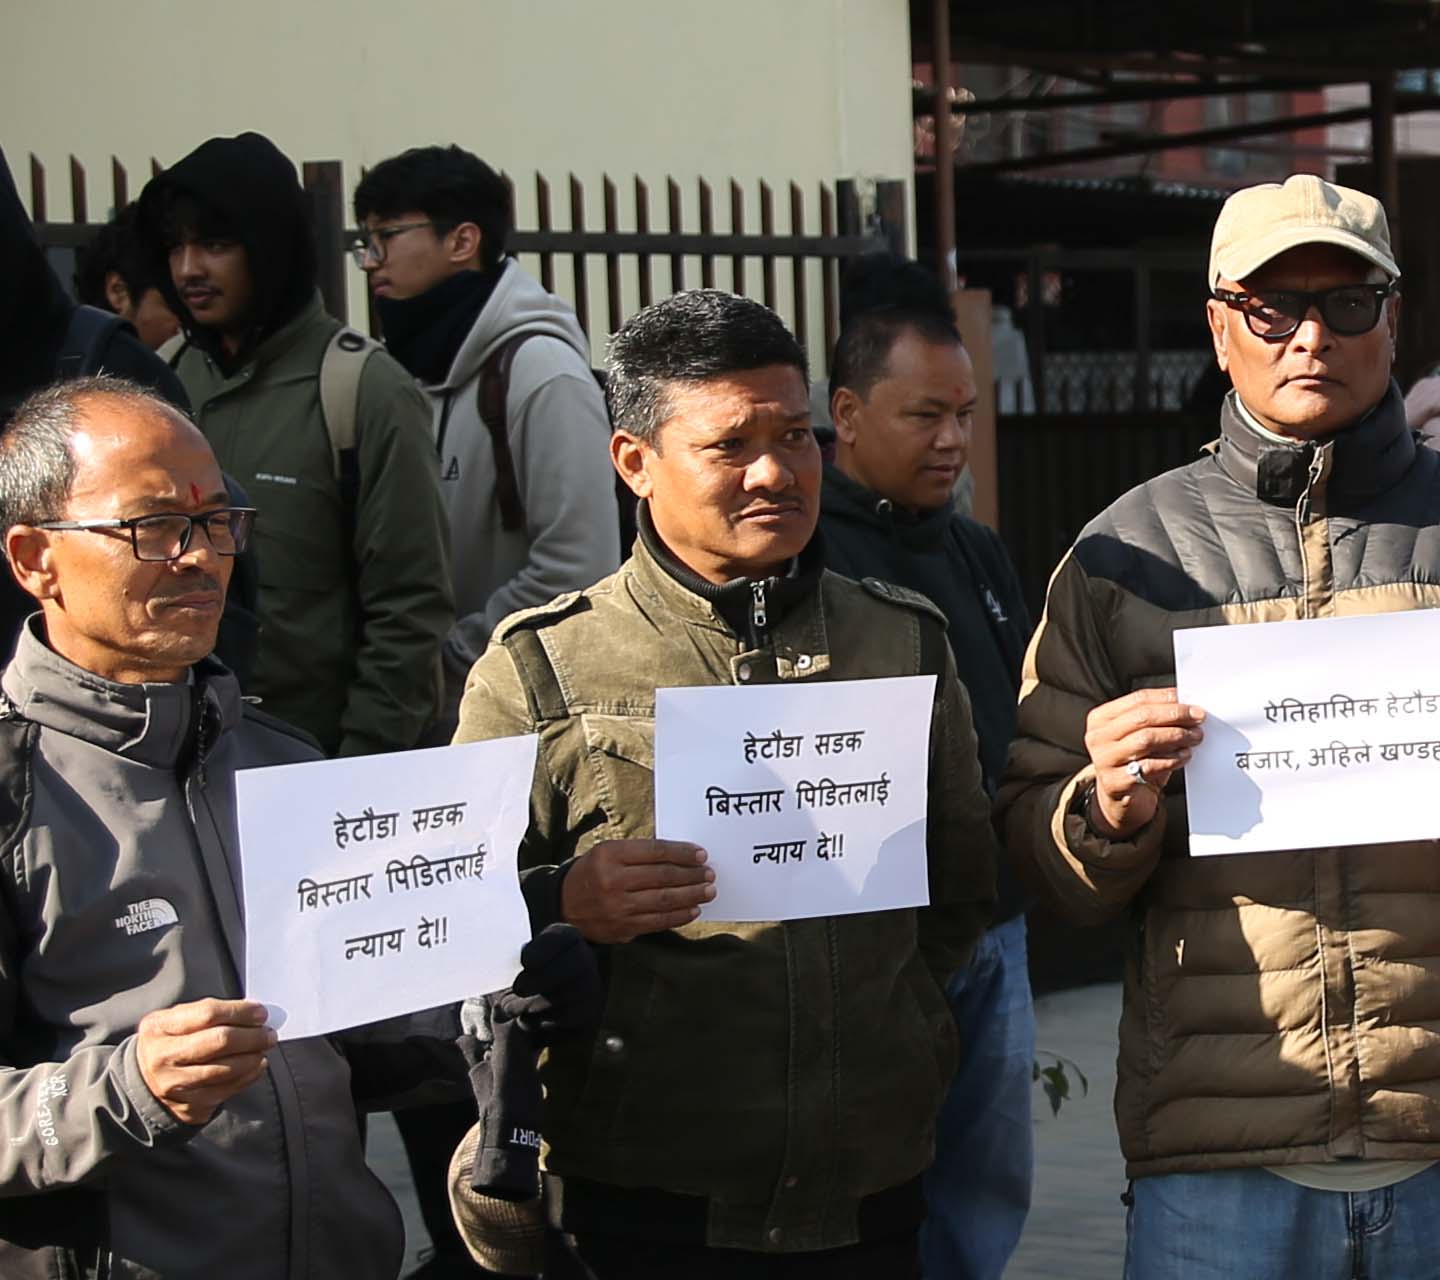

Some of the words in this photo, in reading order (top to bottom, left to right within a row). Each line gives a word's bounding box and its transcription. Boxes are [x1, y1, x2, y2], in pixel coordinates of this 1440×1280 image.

[1264, 693, 1379, 725] ऐतिहासिक
[743, 729, 804, 764] हेटौडा
[814, 730, 865, 757] सडक
[1235, 749, 1301, 773] बजार,
[1308, 739, 1371, 768] अहिले
[705, 786, 785, 817] बिस्तार
[795, 772, 891, 811] पिडितलाई
[333, 807, 399, 849] हेटौडा
[412, 802, 467, 835] सडक
[752, 839, 807, 865] न्याय
[817, 832, 844, 861] दे!!
[297, 873, 373, 913] बिस्तार
[385, 843, 488, 894] पिडितलाई
[114, 909, 153, 929] NORTH
[127, 899, 151, 914] THE
[126, 919, 156, 936] FACE
[344, 928, 406, 961] न्याय
[417, 916, 448, 950] दे!!
